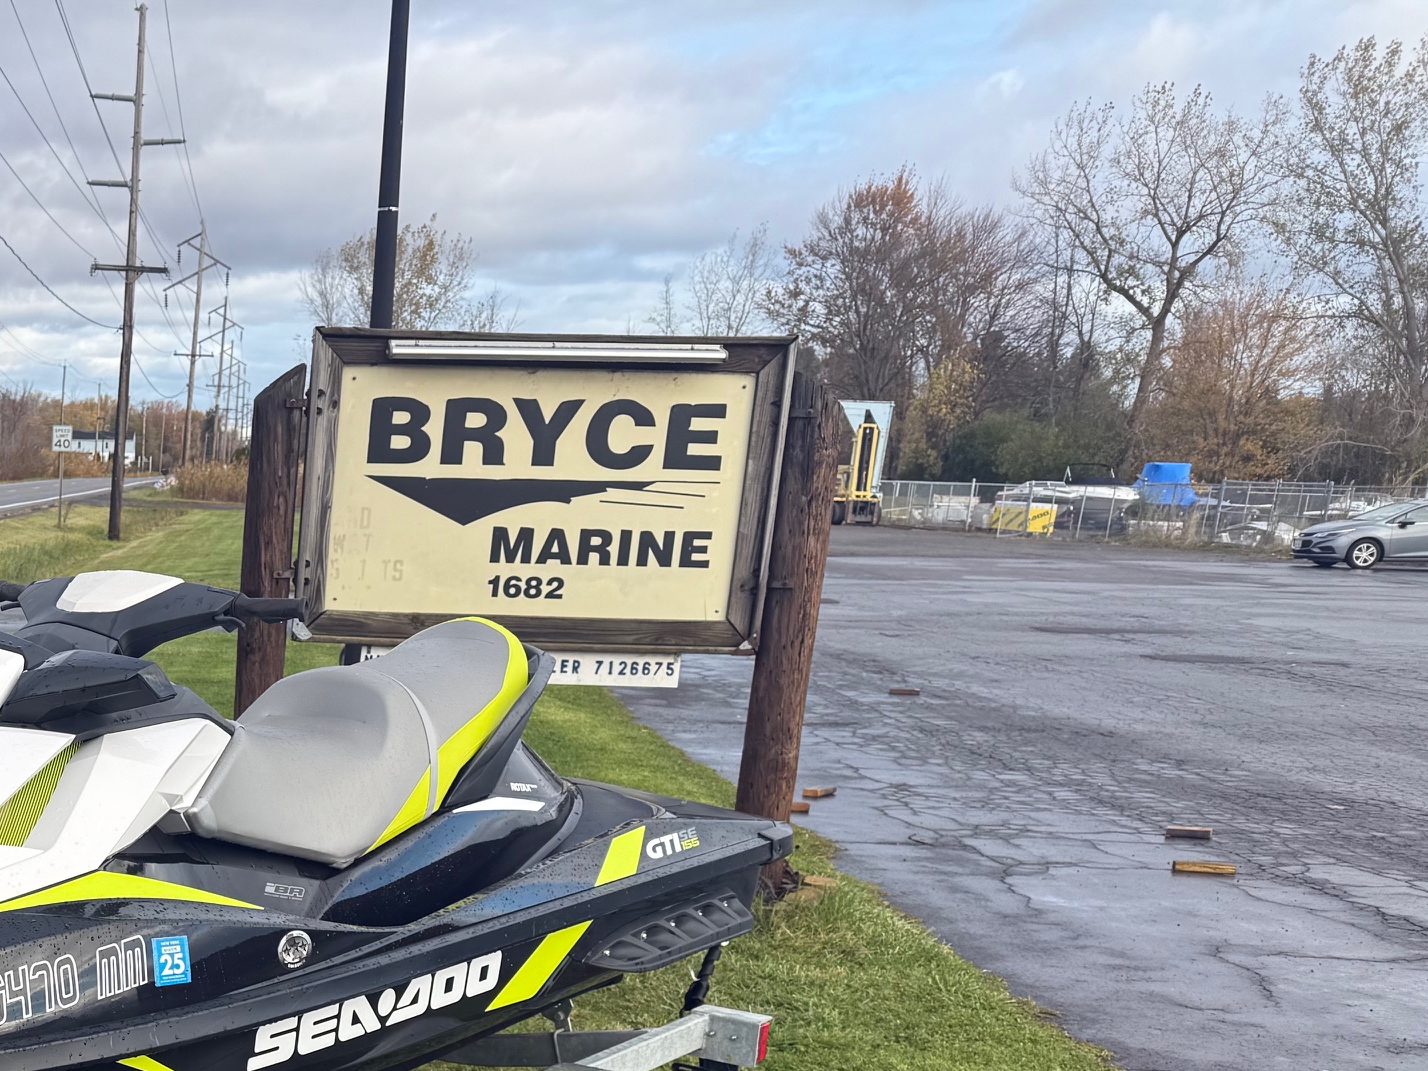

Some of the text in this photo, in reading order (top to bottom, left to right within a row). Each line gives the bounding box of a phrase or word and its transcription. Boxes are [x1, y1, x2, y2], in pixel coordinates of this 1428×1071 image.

[54, 439, 70, 448] 40
[367, 397, 727, 471] BRYCE
[489, 526, 714, 569] MARINE
[487, 575, 565, 600] 1682
[594, 660, 674, 676] 7126675
[646, 827, 698, 860] GTI SE
[681, 837, 700, 851] 155
[160, 952, 186, 976] 25
